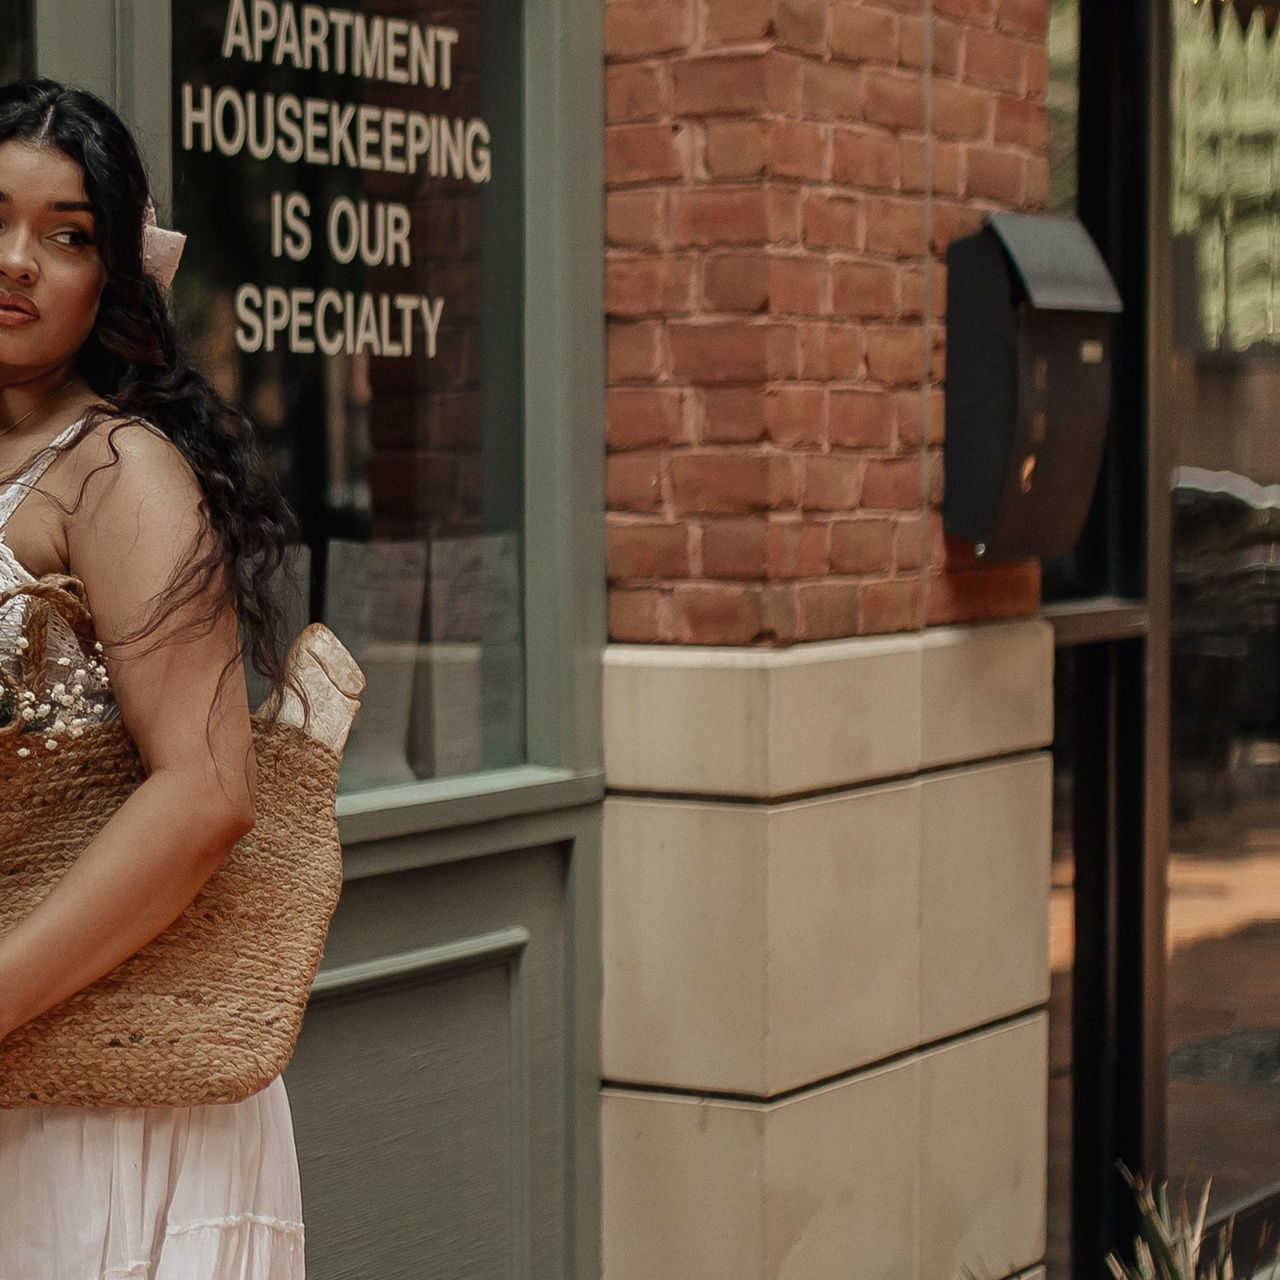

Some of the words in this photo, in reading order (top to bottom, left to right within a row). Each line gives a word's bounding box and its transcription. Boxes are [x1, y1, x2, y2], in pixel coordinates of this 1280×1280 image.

[181, 82, 492, 184] HOUSEKEEPING
[271, 191, 312, 262] IS
[328, 195, 412, 267] OUR
[234, 282, 446, 359] SPECIALTY
